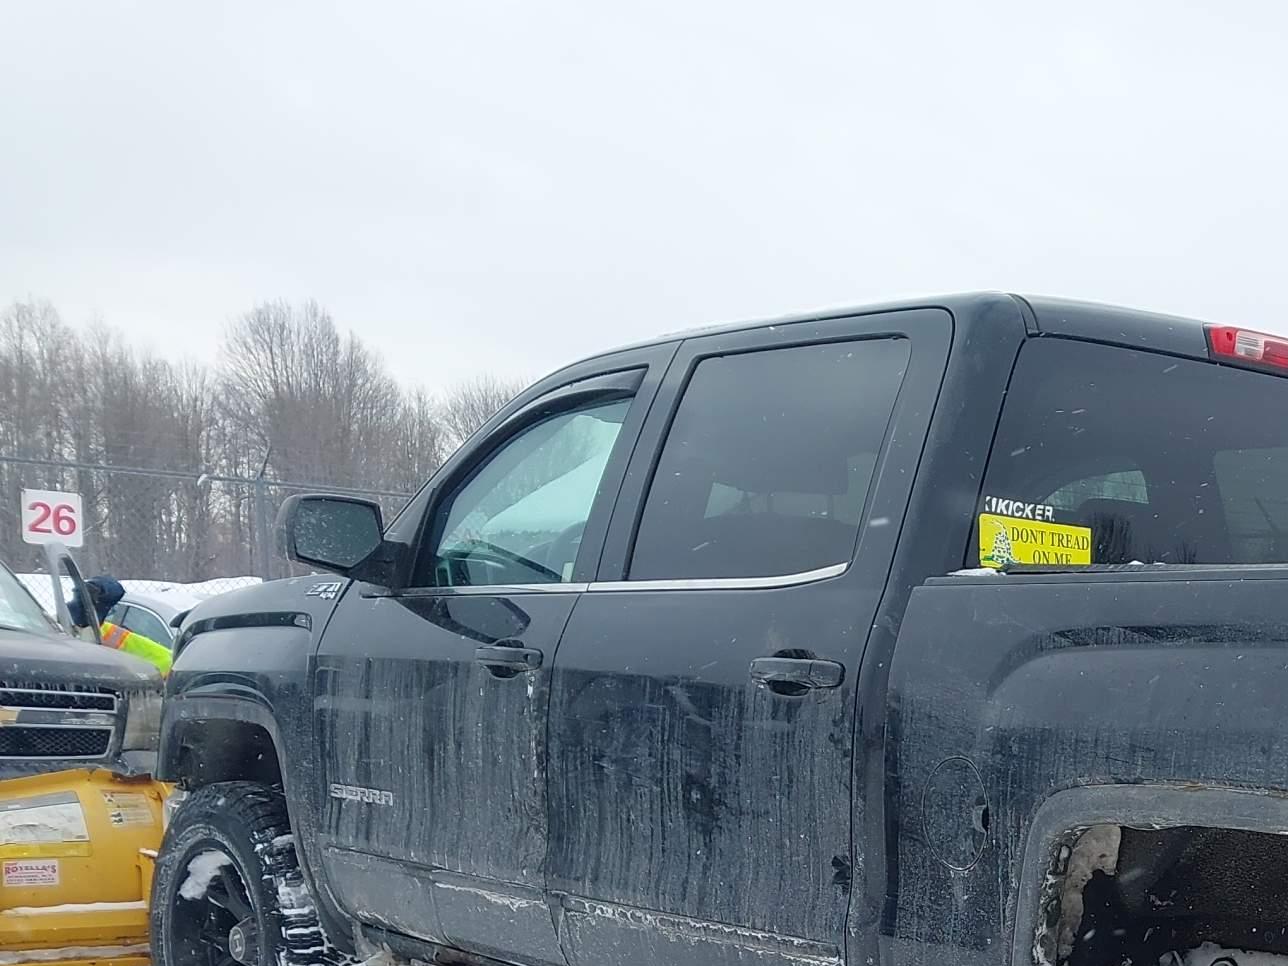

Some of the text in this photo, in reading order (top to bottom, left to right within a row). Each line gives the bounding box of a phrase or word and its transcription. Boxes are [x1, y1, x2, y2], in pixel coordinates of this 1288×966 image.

[28, 501, 77, 536] 26
[1011, 527, 1089, 550] DONT TREAD
[1032, 549, 1072, 566] ON ME
[329, 783, 394, 807] SIERRA
